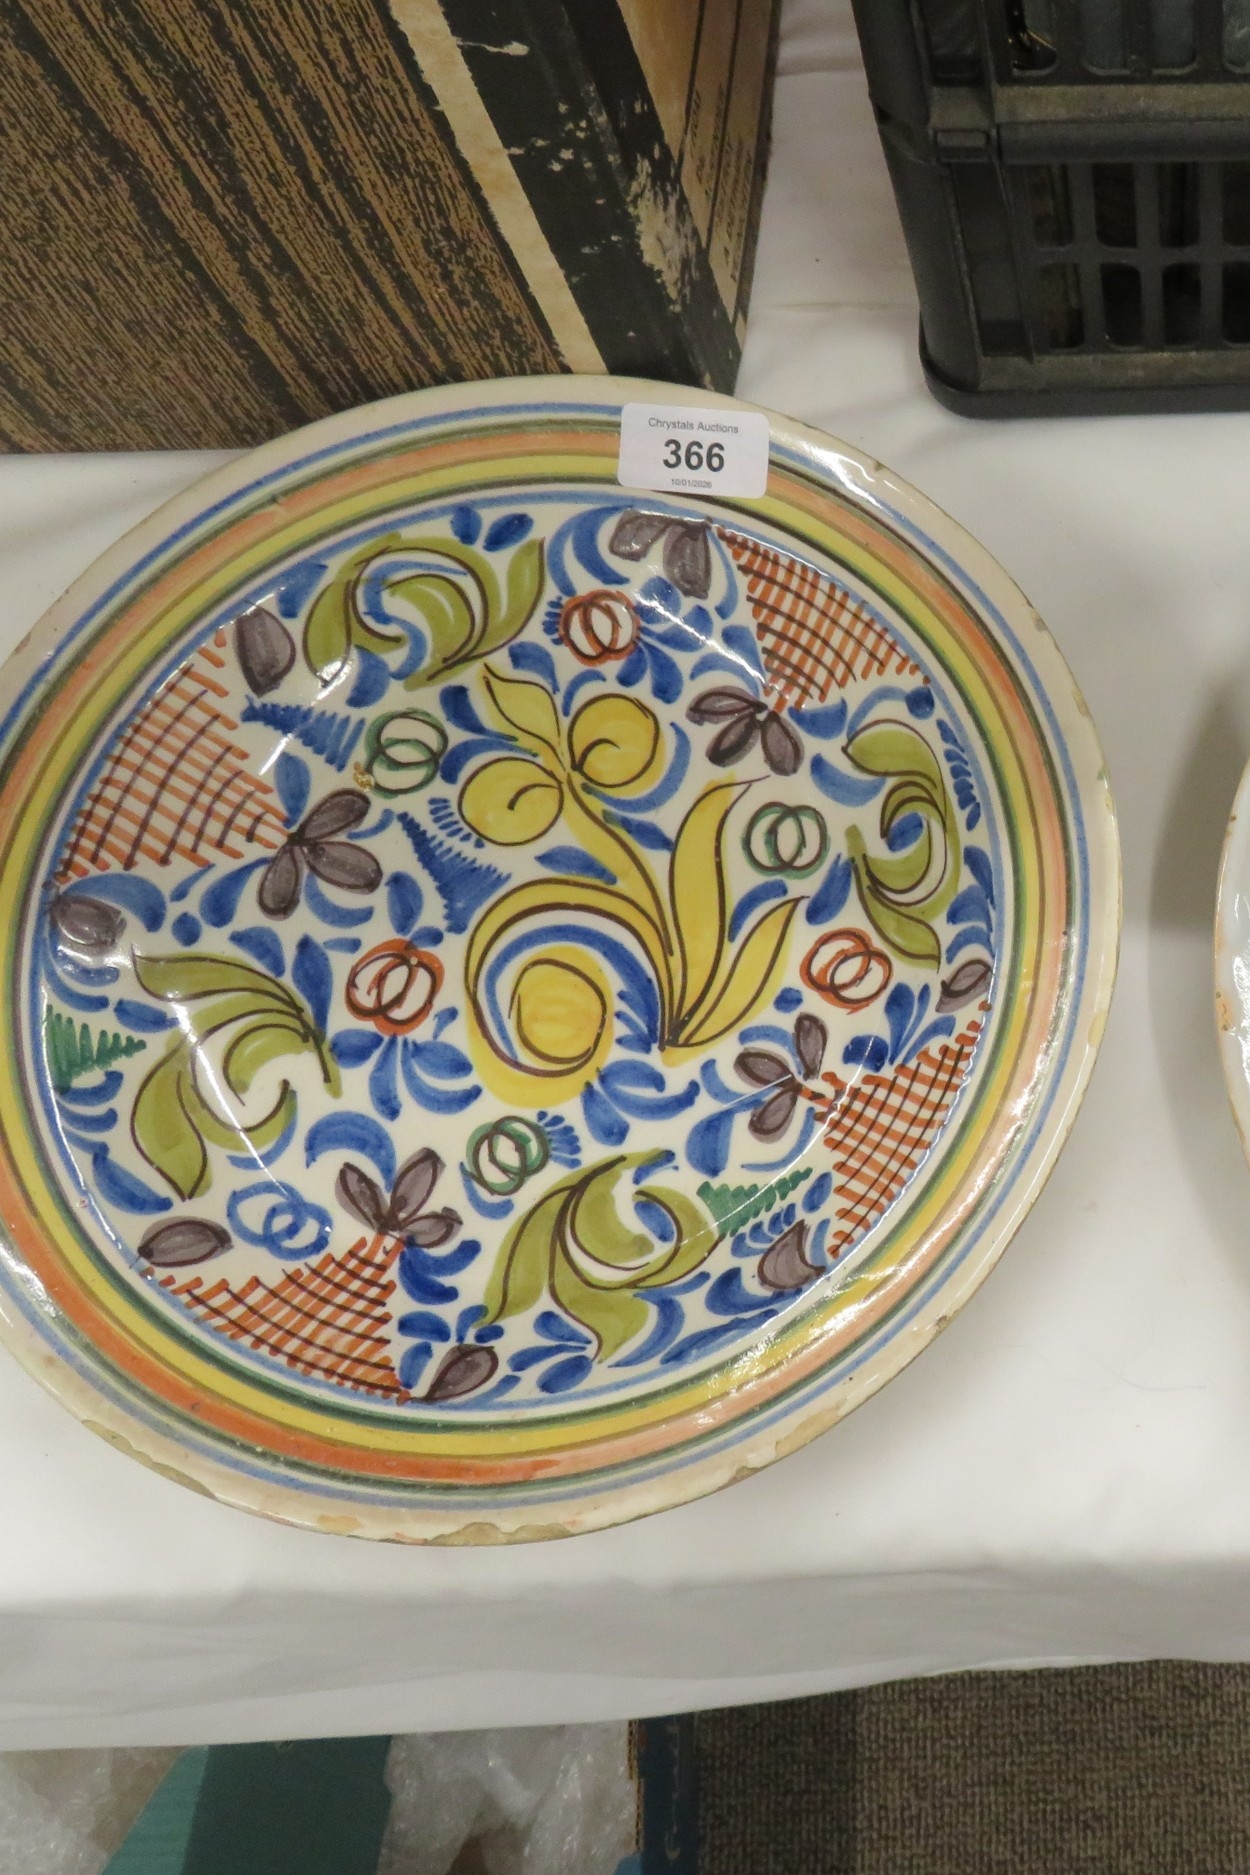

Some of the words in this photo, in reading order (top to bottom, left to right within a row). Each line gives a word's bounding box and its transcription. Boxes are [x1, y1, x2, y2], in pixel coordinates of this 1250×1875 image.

[648, 417, 694, 431] Chrystals
[697, 421, 739, 434] Auctions
[663, 438, 725, 472] 366
